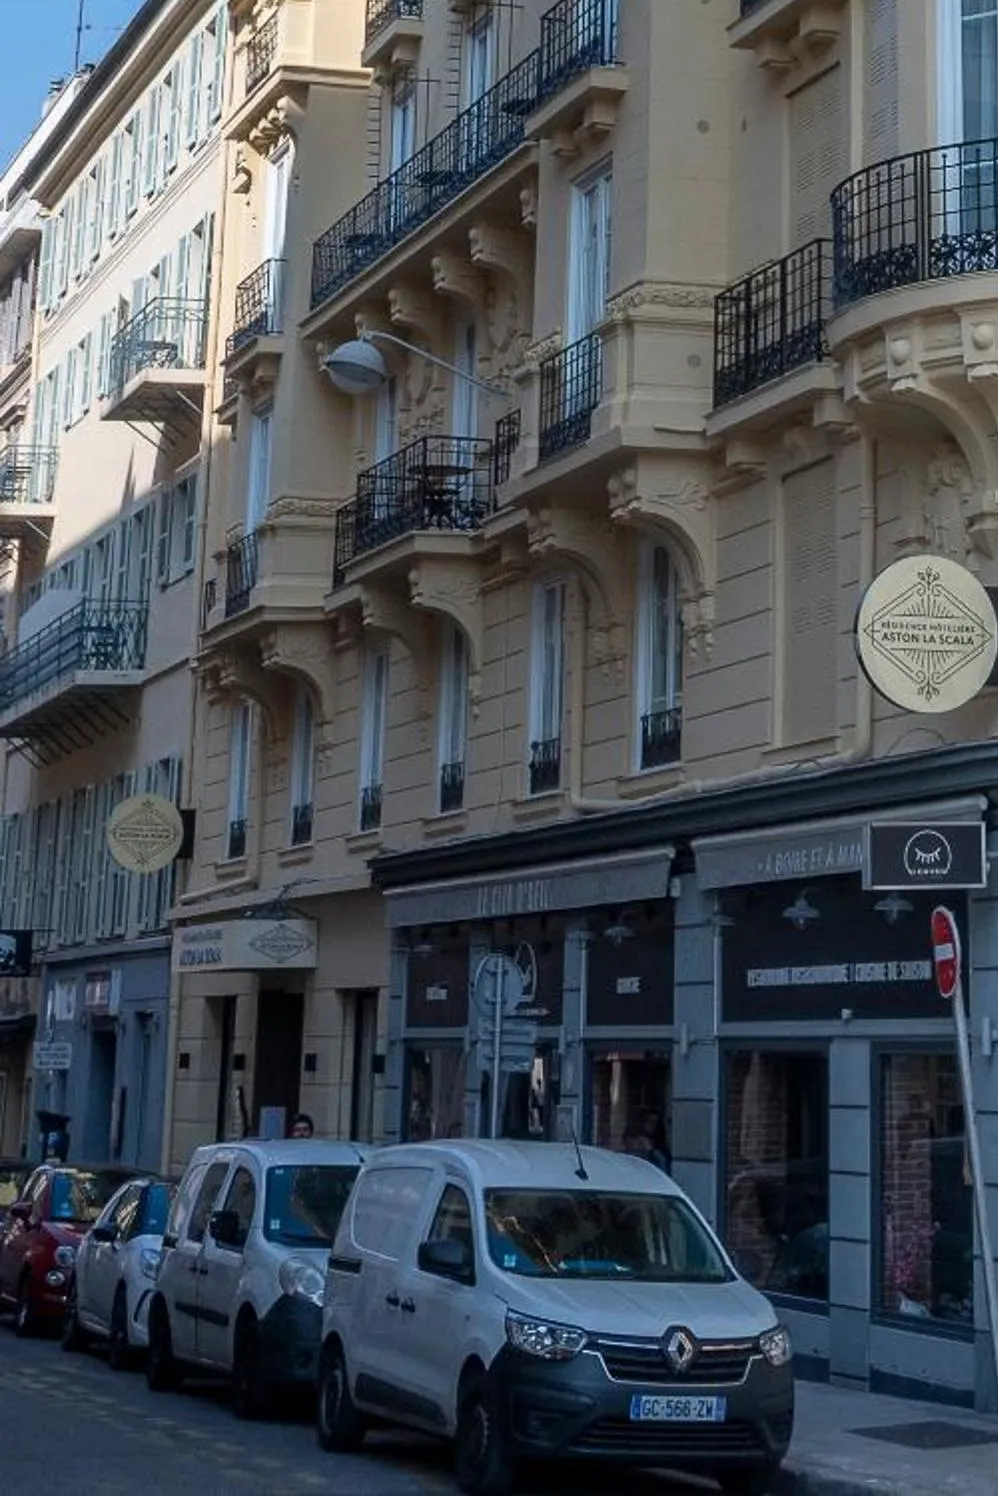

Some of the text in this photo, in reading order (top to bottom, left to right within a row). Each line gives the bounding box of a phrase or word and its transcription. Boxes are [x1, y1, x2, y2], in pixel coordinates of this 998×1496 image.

[881, 632, 975, 645] ASTON LA SCALA
